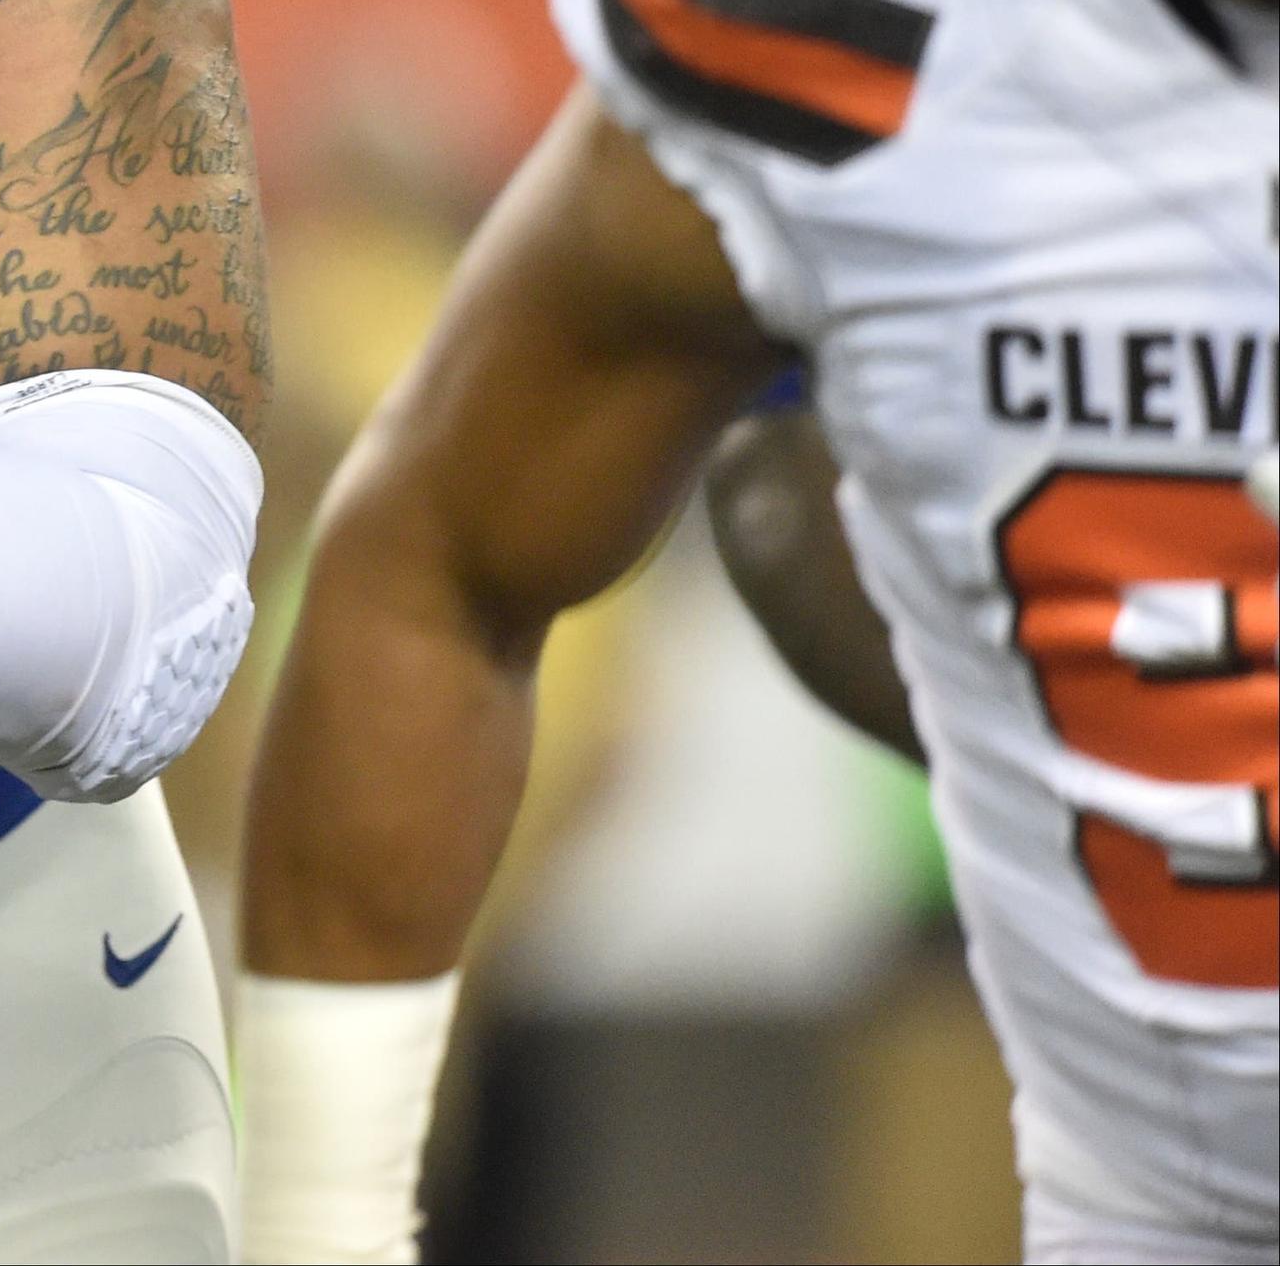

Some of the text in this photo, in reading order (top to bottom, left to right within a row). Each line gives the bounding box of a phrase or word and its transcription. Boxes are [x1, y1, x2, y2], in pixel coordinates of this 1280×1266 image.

[31, 186, 117, 235] the
[88, 249, 198, 301] most
[984, 326, 1279, 436] CLEV
